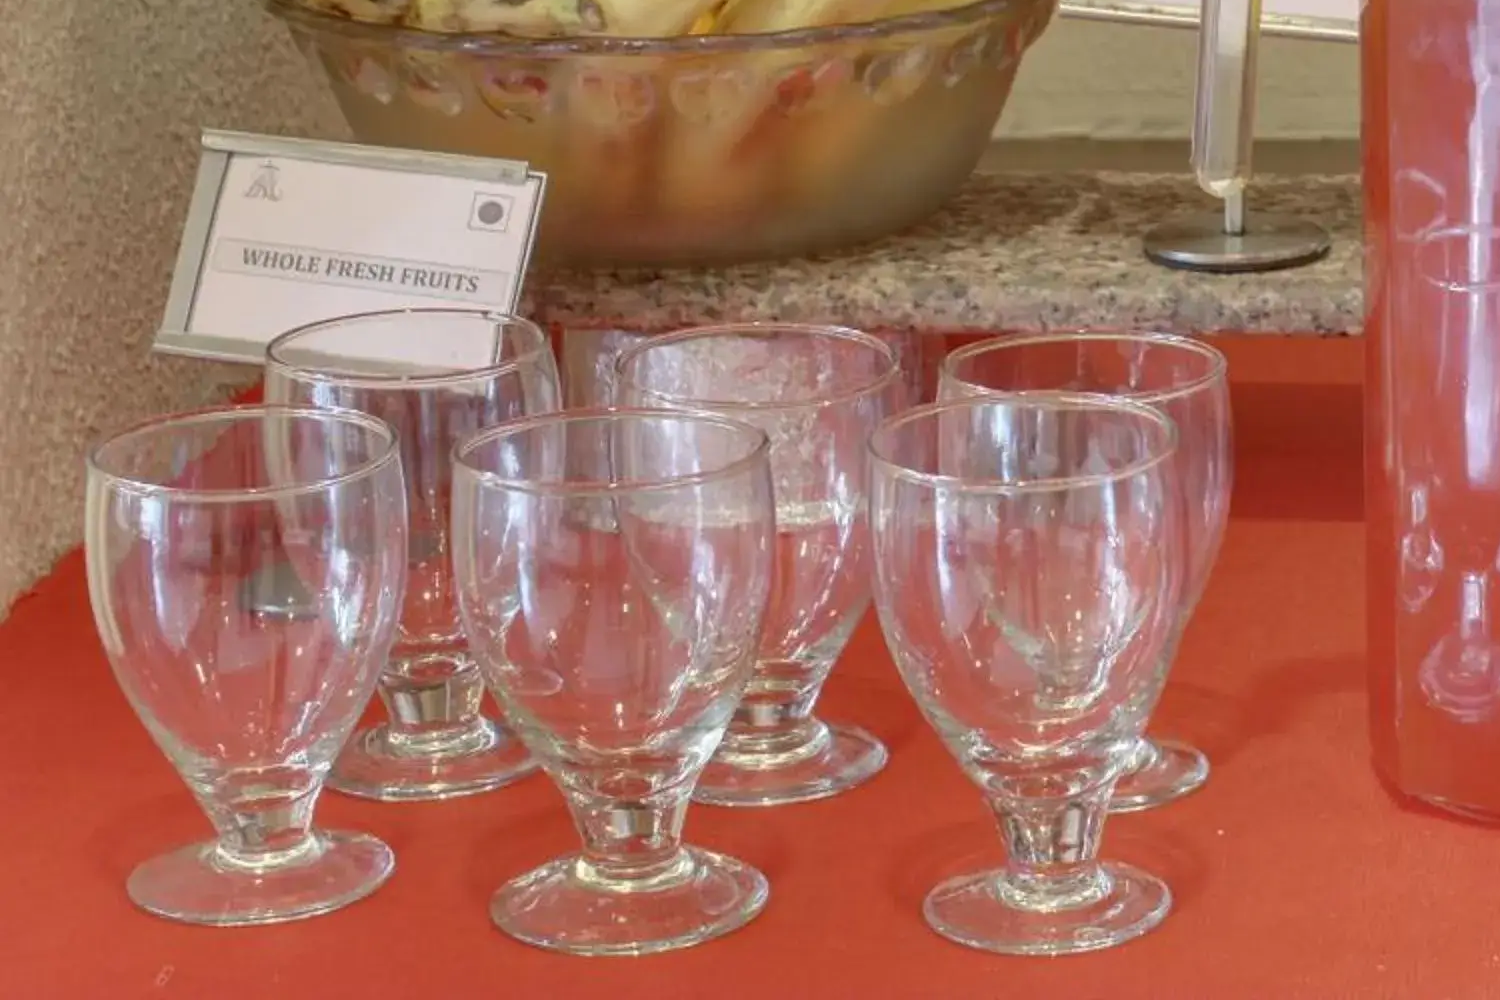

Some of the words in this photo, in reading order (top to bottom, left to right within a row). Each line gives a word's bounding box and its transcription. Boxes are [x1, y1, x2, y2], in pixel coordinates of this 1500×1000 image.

[242, 247, 321, 274] WHOLE
[325, 256, 396, 283] FRESH
[400, 267, 480, 294] FRUITS
